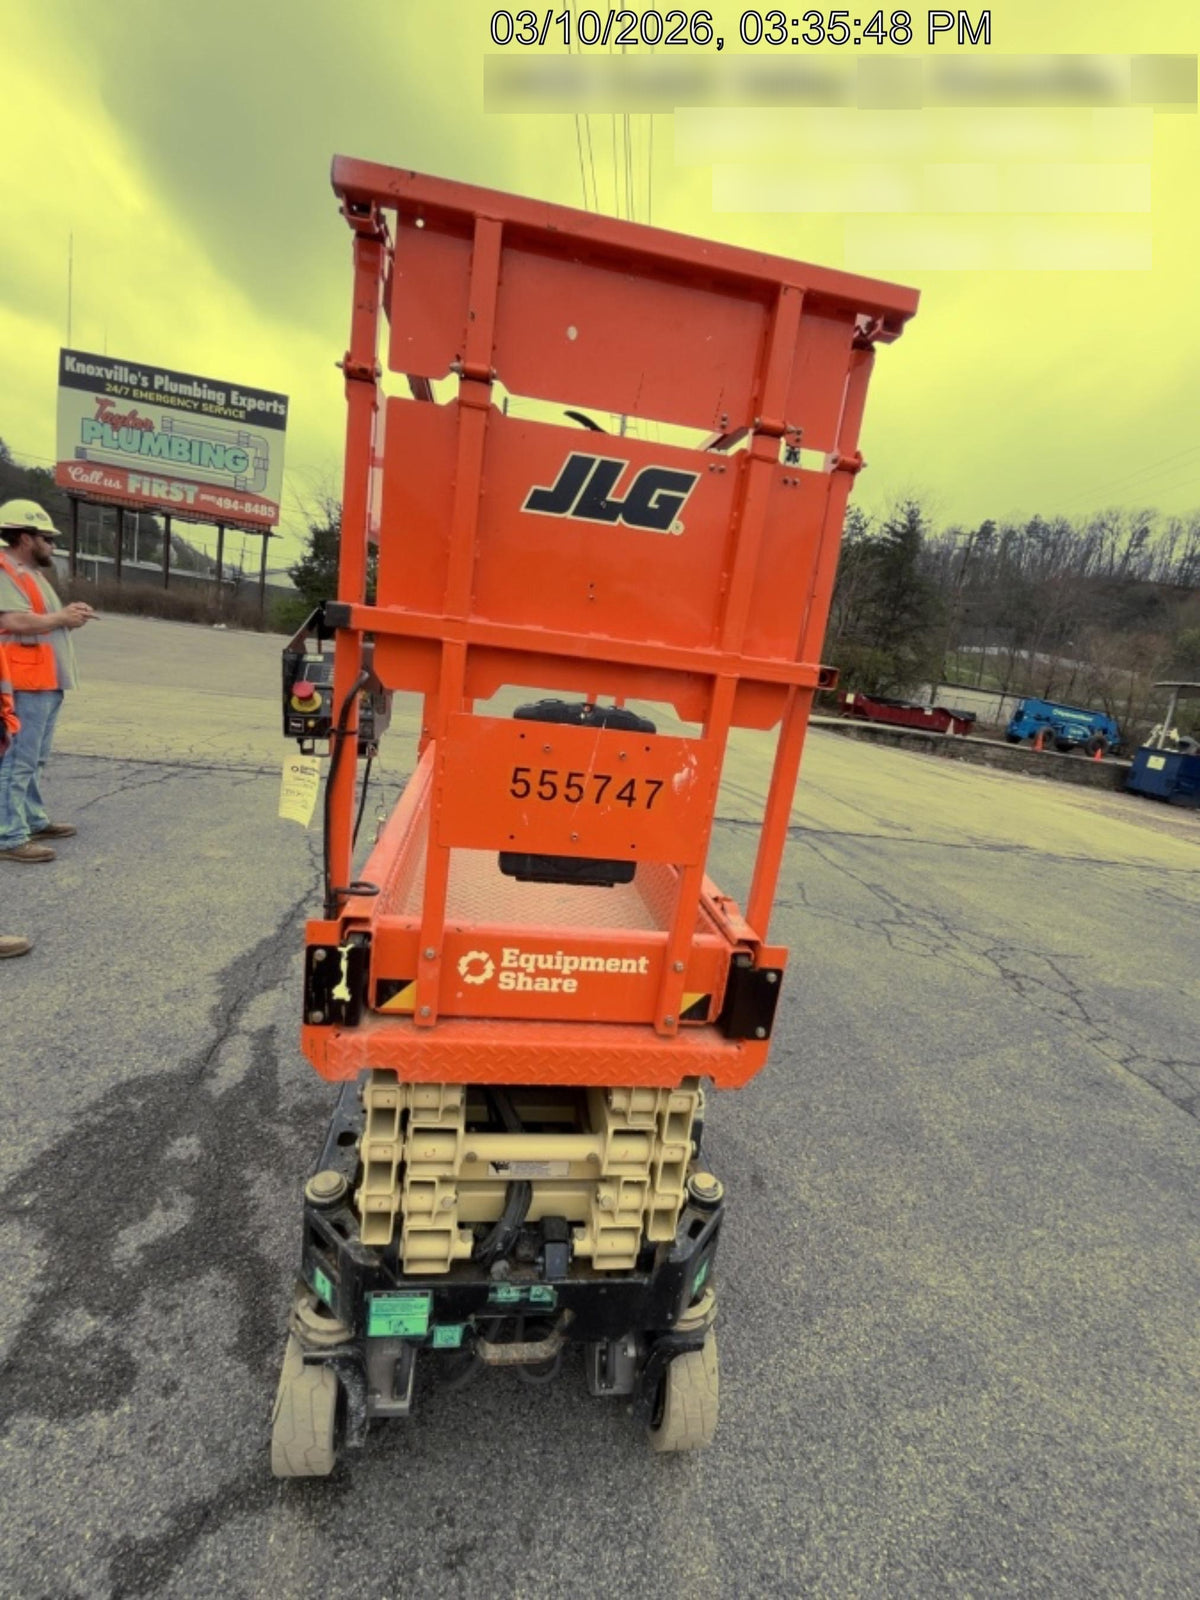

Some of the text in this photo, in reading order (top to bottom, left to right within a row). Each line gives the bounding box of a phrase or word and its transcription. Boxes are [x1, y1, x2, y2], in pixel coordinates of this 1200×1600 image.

[64, 355, 287, 415] Knoxville's Plumbing Experts
[105, 383, 247, 419] 24/7 EMERGENCY SERVICE
[81, 417, 249, 474] PLUMBING
[68, 465, 104, 486] Call
[103, 478, 123, 490] us
[127, 473, 198, 505] FIRST
[520, 450, 702, 534] JLG
[510, 767, 664, 809] 555747
[497, 970, 579, 993] Share
[501, 947, 650, 975] Equipment
